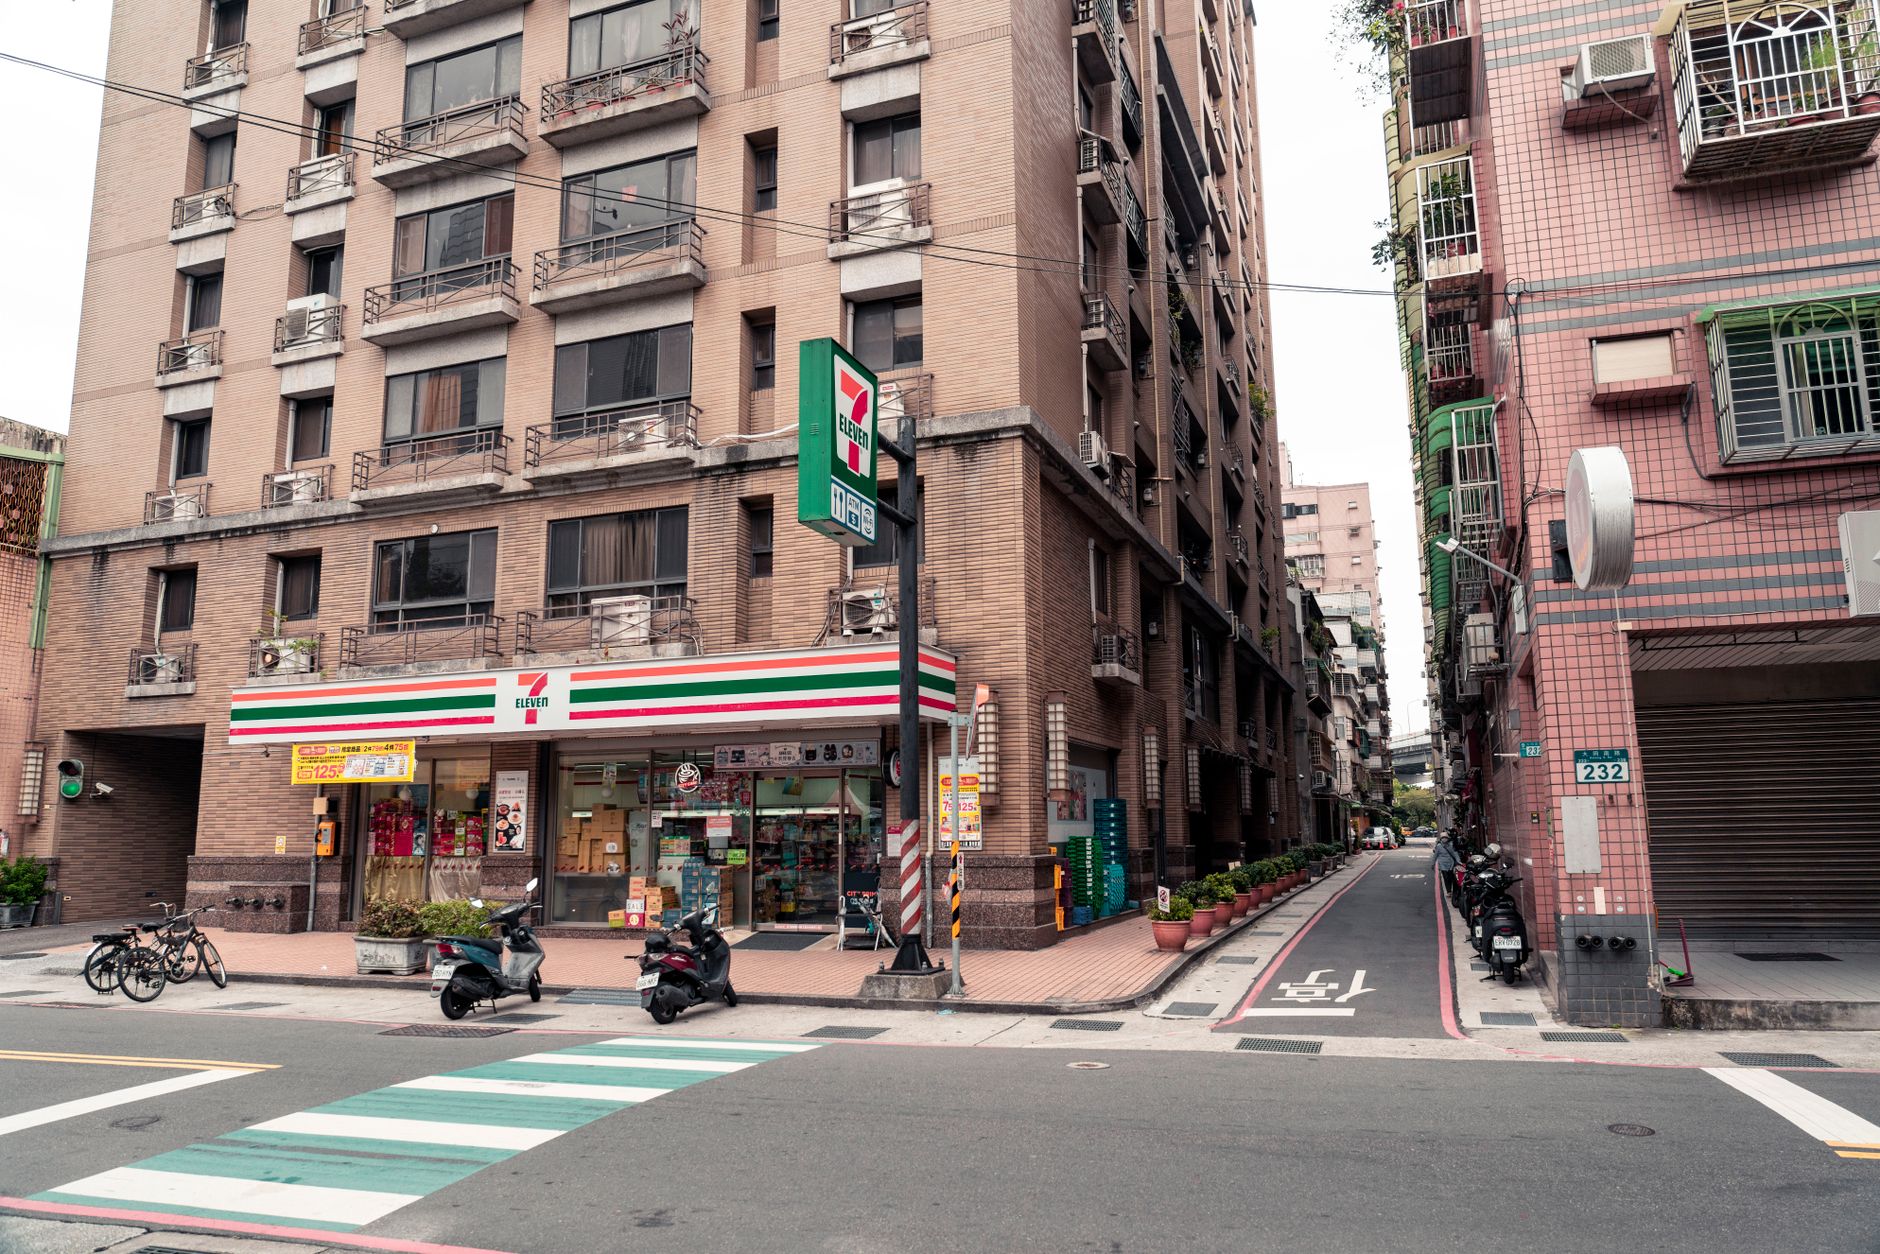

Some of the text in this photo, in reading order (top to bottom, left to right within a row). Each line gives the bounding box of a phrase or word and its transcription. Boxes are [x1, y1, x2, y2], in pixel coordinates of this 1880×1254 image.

[840, 369, 868, 475] 7
[849, 497, 860, 512] ATM
[517, 672, 548, 725] 7
[313, 764, 337, 779] 125
[1583, 763, 1623, 780] 232
